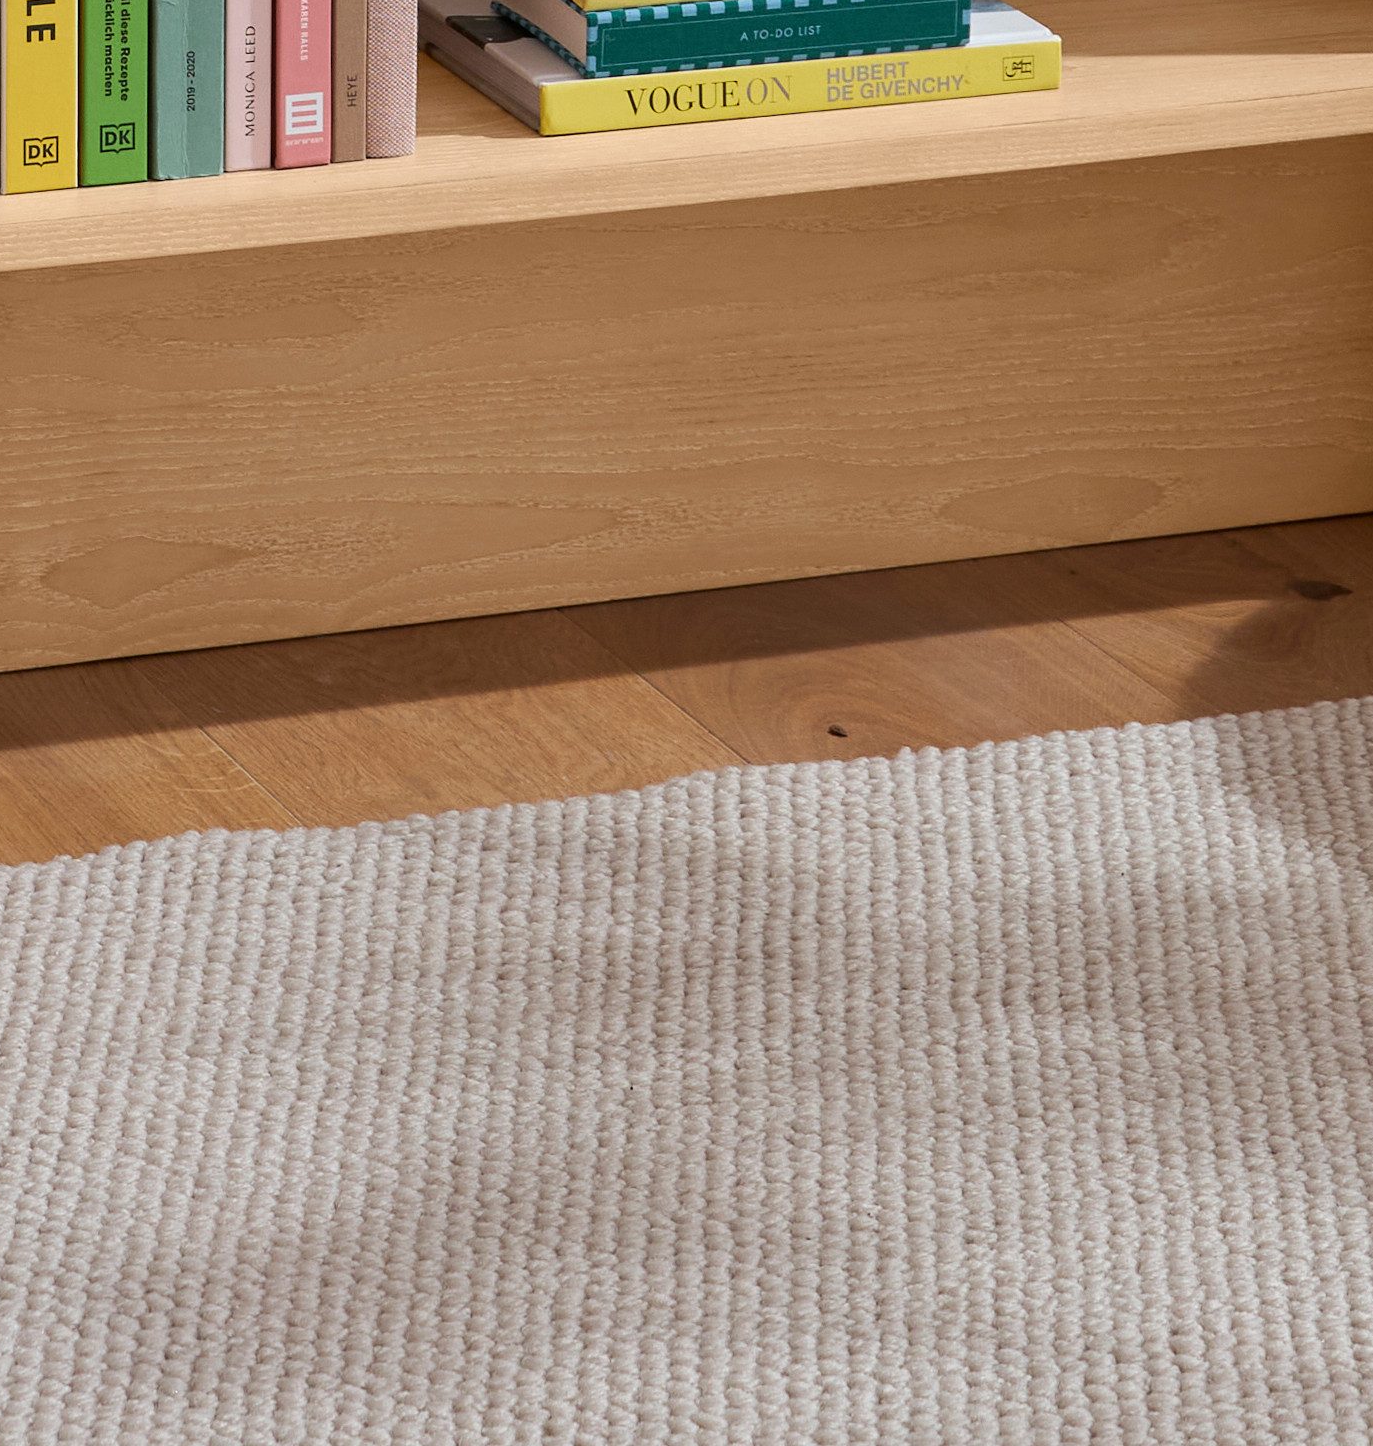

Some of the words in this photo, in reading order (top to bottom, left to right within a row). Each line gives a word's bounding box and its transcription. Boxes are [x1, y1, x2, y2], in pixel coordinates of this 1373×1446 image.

[120, 8, 130, 44] diese
[740, 32, 749, 41] A
[753, 27, 794, 40] TO-DO
[798, 25, 822, 36] LIST
[245, 24, 256, 63] LEED
[104, 45, 114, 97] machen
[118, 47, 130, 101] Rezepte
[186, 50, 196, 78] 2020
[827, 62, 910, 84] HUBERT
[186, 87, 196, 112] 2019
[347, 74, 358, 108] HEYE
[625, 80, 740, 117] VOGUE
[746, 75, 793, 106] ON
[827, 82, 855, 102] DE
[860, 74, 966, 100] GIVENCHY
[244, 71, 256, 137] MONICA
[28, 143, 54, 159] DK
[105, 129, 131, 147] DK
